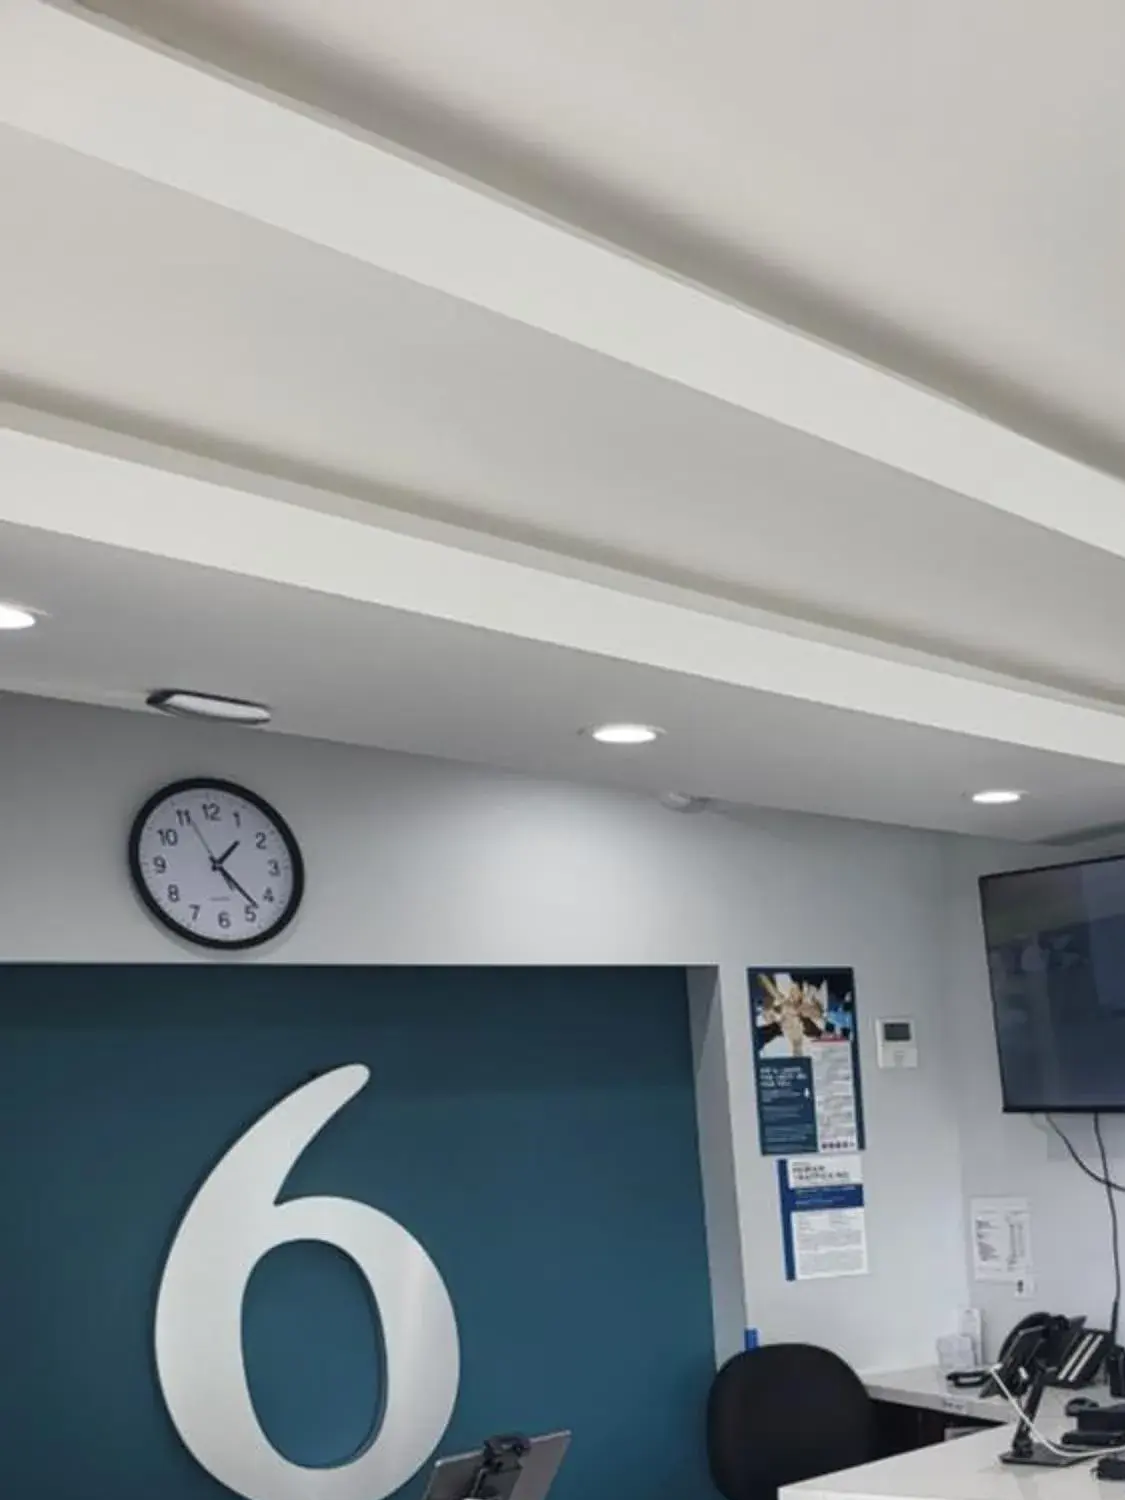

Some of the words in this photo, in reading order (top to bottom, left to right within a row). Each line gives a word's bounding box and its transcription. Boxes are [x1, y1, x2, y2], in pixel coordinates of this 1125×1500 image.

[176, 809, 192, 827] 11
[202, 803, 221, 821] 12
[232, 811, 241, 828] 1
[157, 828, 178, 846] 10
[255, 831, 267, 850] 2
[153, 856, 167, 874] 9
[267, 859, 281, 877] 3
[167, 884, 181, 902] 8
[263, 886, 275, 903] 4
[189, 904, 200, 921] 7
[217, 911, 231, 929] 6
[244, 905, 257, 923] 5
